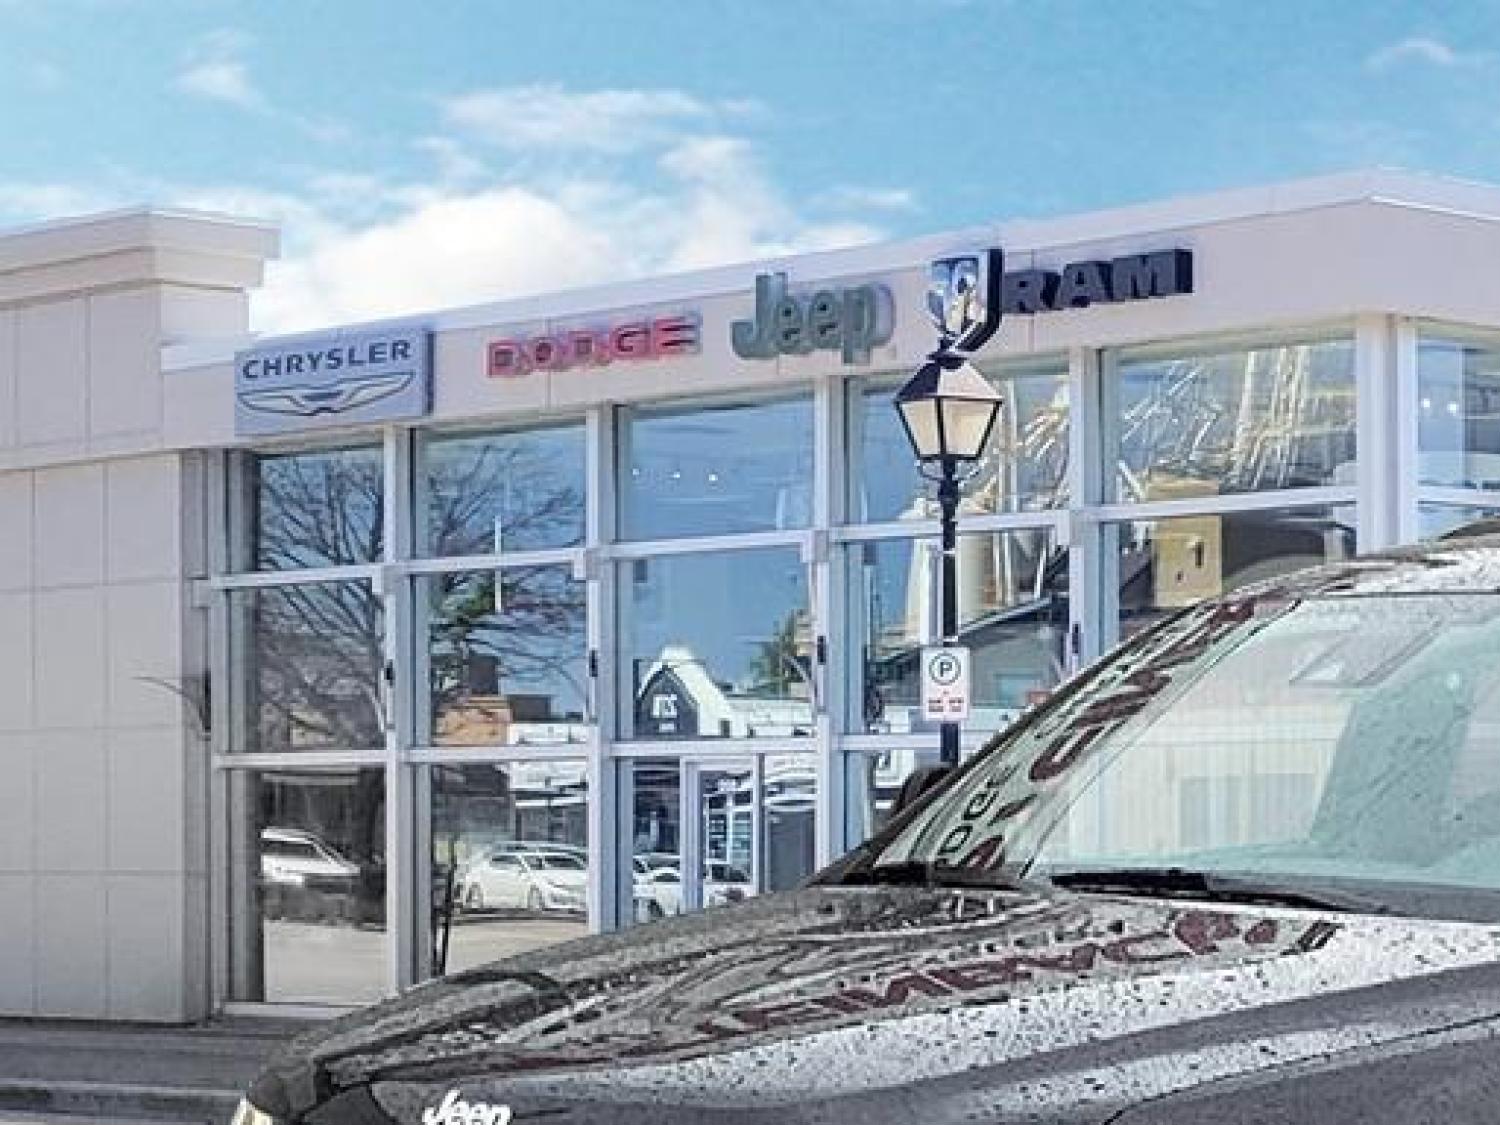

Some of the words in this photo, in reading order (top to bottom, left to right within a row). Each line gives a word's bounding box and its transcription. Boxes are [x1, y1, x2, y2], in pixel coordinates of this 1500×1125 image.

[1002, 249, 1194, 314] RAM
[486, 313, 702, 378] DODGE
[732, 272, 897, 365] Jeep
[242, 339, 412, 380] CHRYSLER
